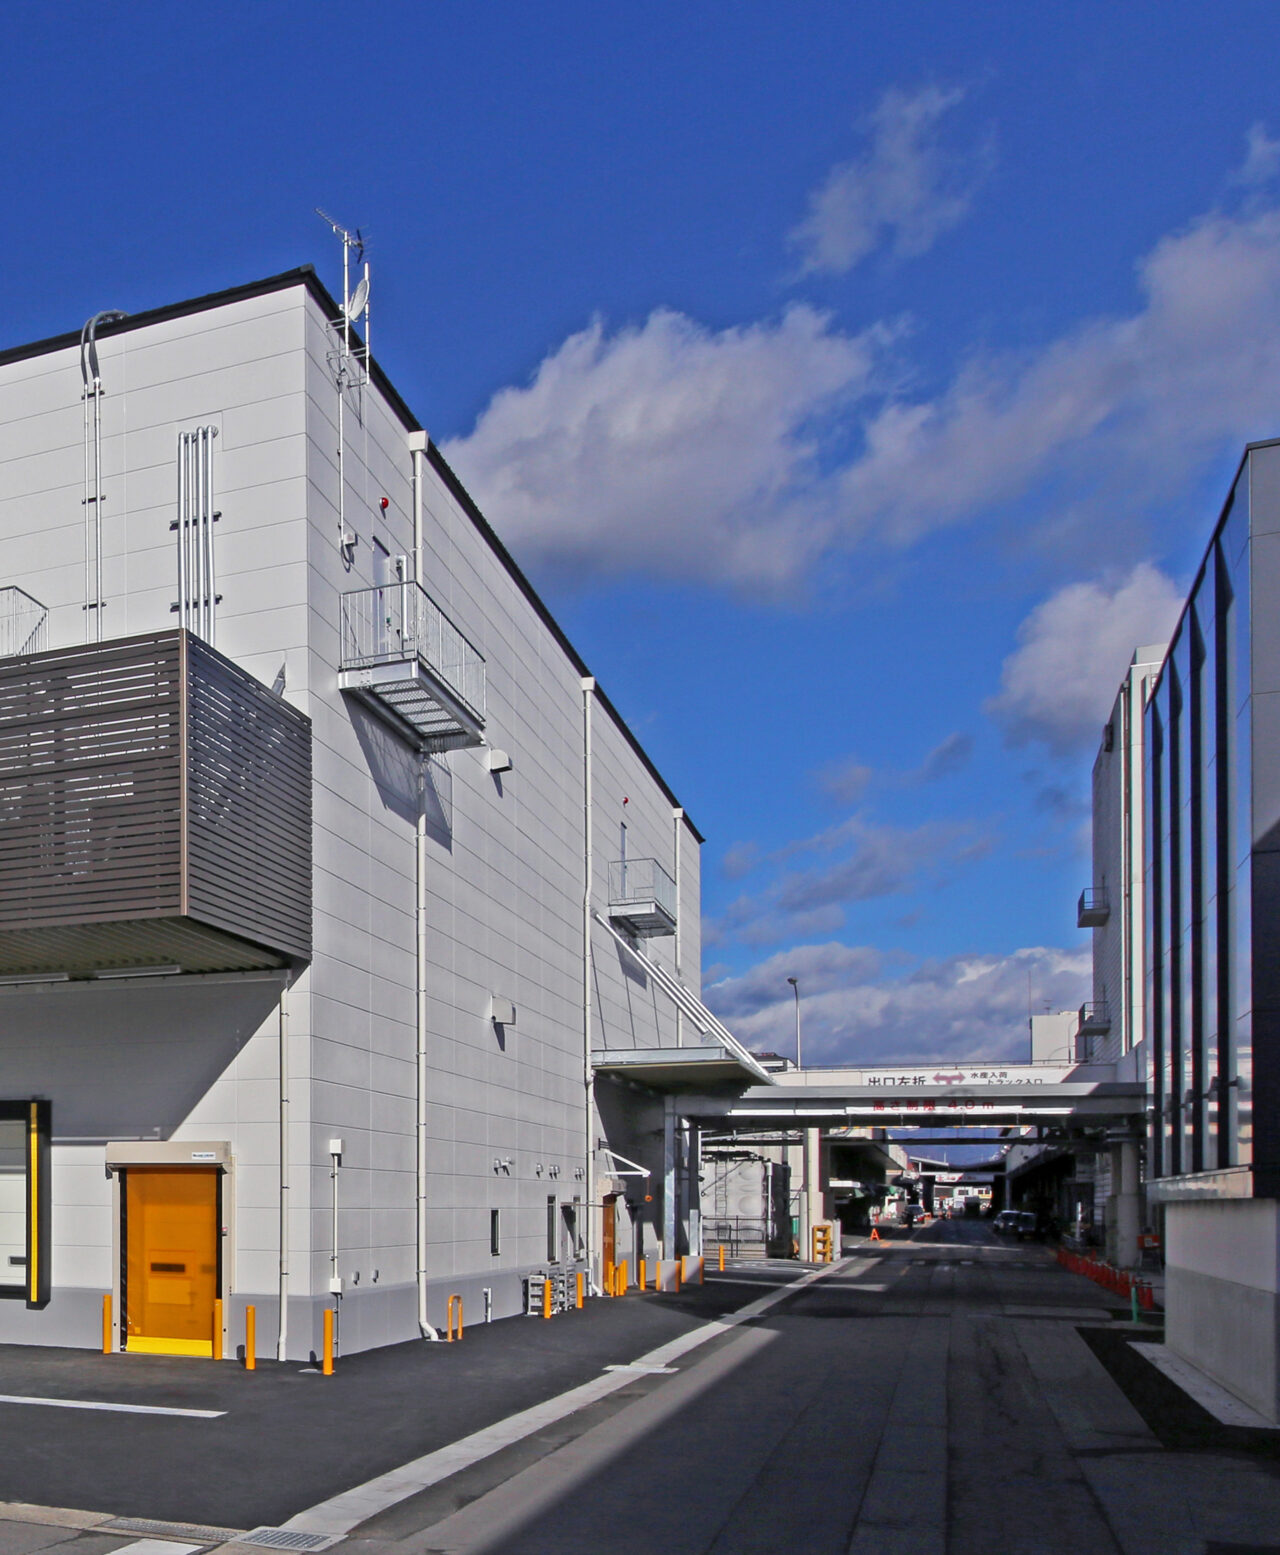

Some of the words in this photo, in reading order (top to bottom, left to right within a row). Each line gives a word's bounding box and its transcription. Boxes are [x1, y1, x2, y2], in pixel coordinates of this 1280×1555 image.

[970, 1071, 1008, 1079] 水産入荷
[867, 1075, 927, 1086] 出口左折
